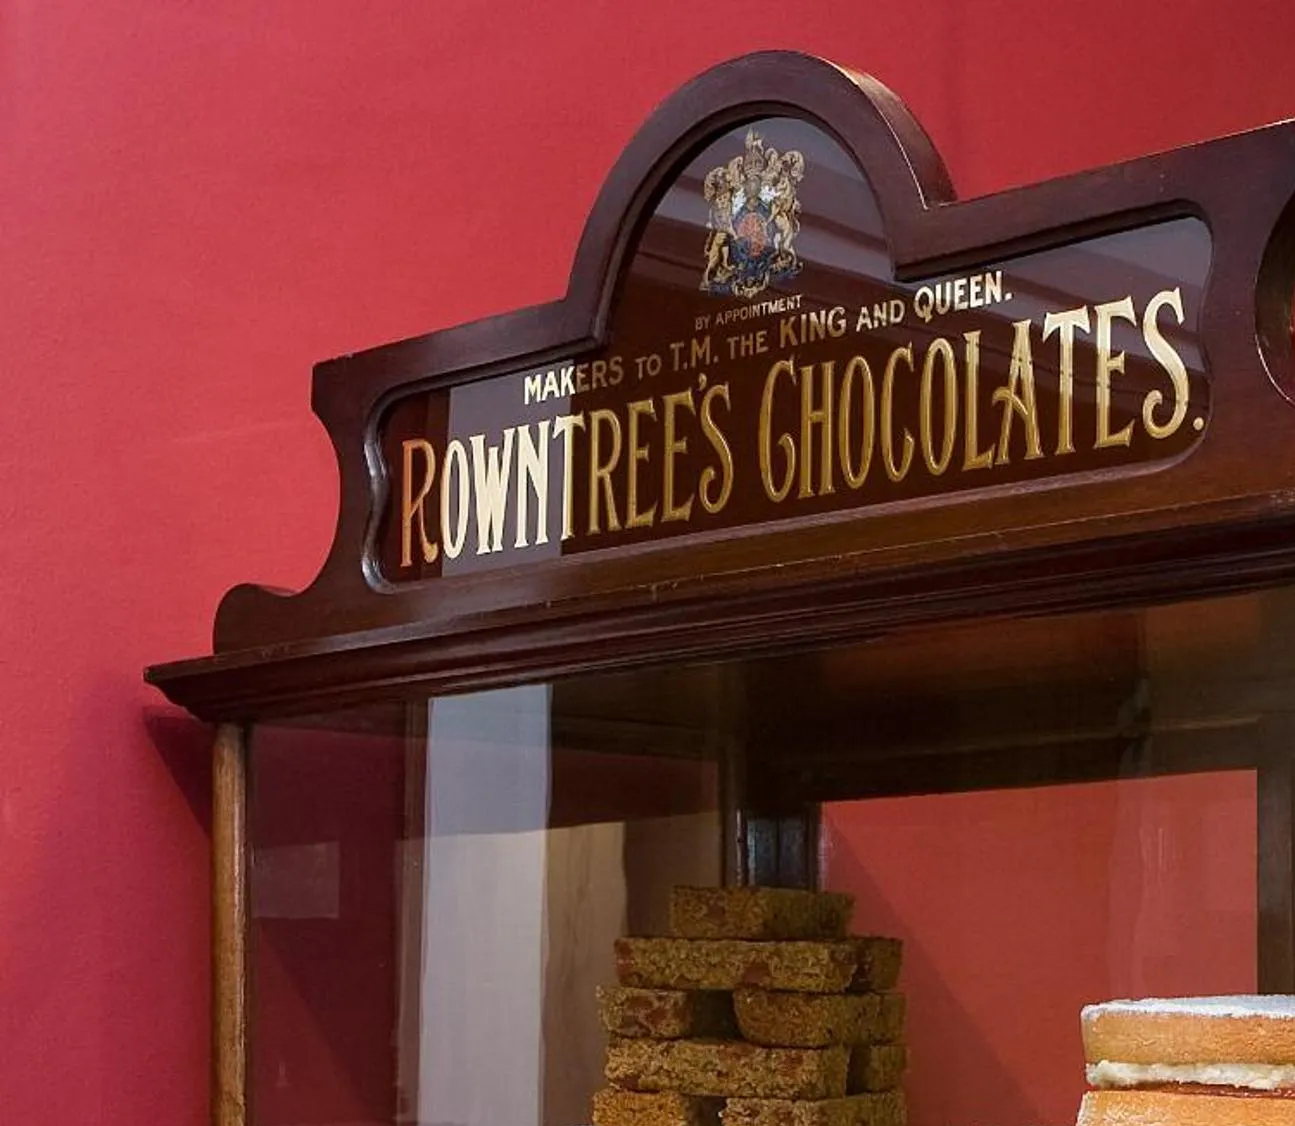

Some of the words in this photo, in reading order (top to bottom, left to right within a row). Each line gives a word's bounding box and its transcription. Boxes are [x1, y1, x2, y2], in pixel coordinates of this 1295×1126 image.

[524, 356, 624, 405] MAKERS
[635, 354, 662, 380] TO
[670, 335, 719, 371] T.M.
[727, 330, 769, 360] THE
[779, 306, 847, 348] KING
[856, 299, 905, 332] AND
[914, 270, 1014, 323] QUEEN.
[695, 316, 711, 330] BY
[716, 294, 803, 326] APPOINTMENT
[400, 373, 734, 568] ROWNTREE'S
[758, 287, 1206, 503] CHOCOLATES.
